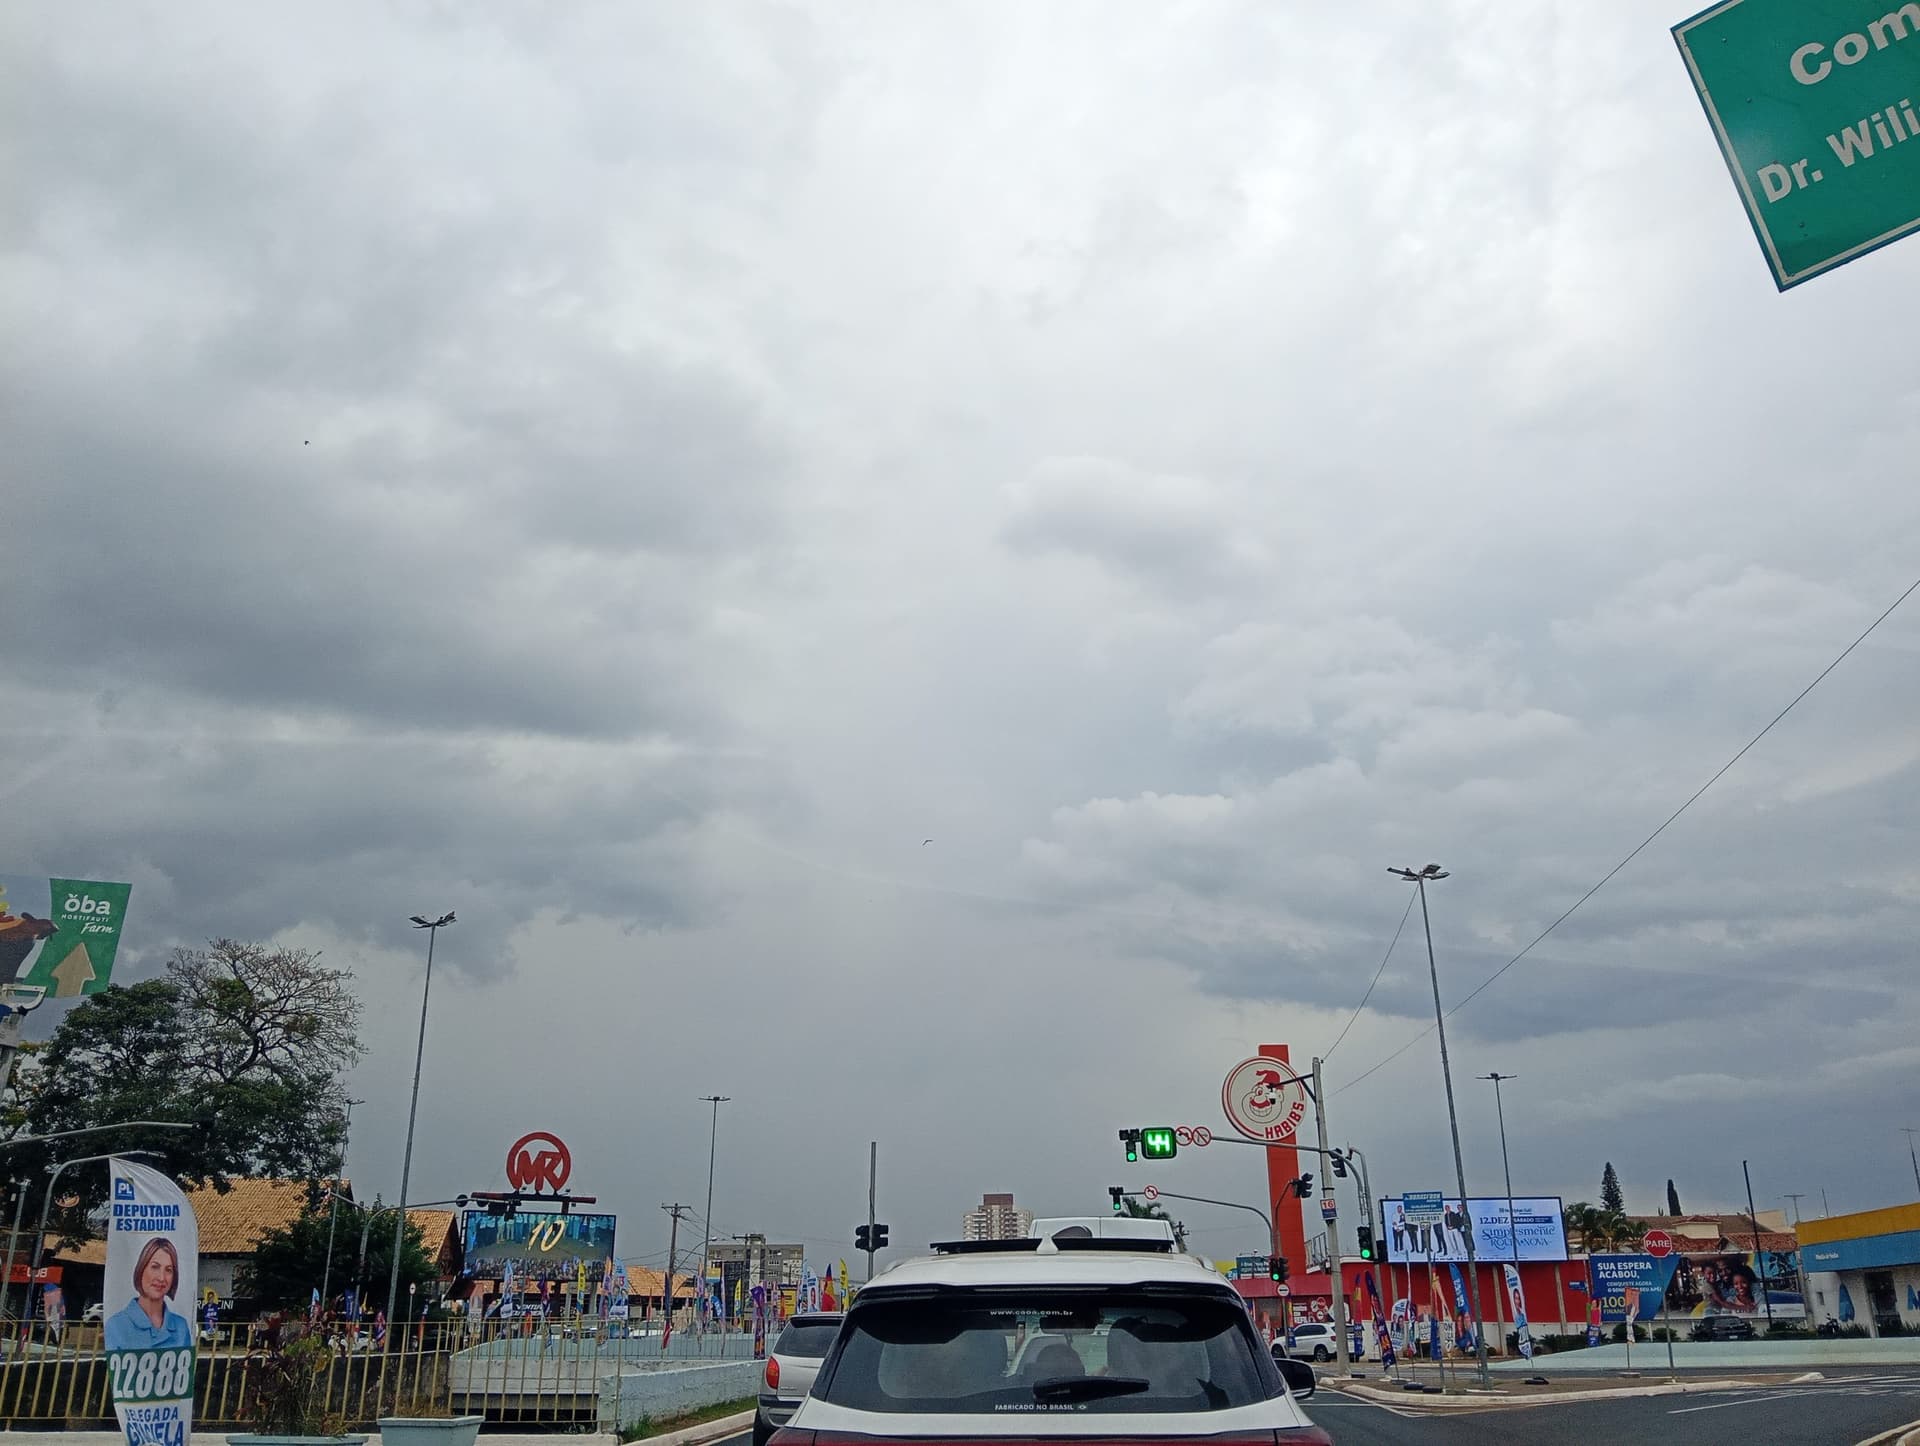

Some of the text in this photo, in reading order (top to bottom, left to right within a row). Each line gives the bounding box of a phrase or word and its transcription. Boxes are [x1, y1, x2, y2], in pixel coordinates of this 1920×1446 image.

[1757, 97, 1920, 203] Dr. Wili
[1147, 1133, 1170, 1151] 44
[118, 1182, 132, 1194] PL
[113, 1204, 180, 1217] DEPUTADA
[116, 1218, 176, 1231] ESTADUAL
[525, 1219, 566, 1251] 10
[1646, 1239, 1670, 1248] PARE
[1598, 1262, 1652, 1270] SUA ESPERA
[1599, 1271, 1640, 1279] ACABOU,
[110, 1350, 191, 1398] 22888
